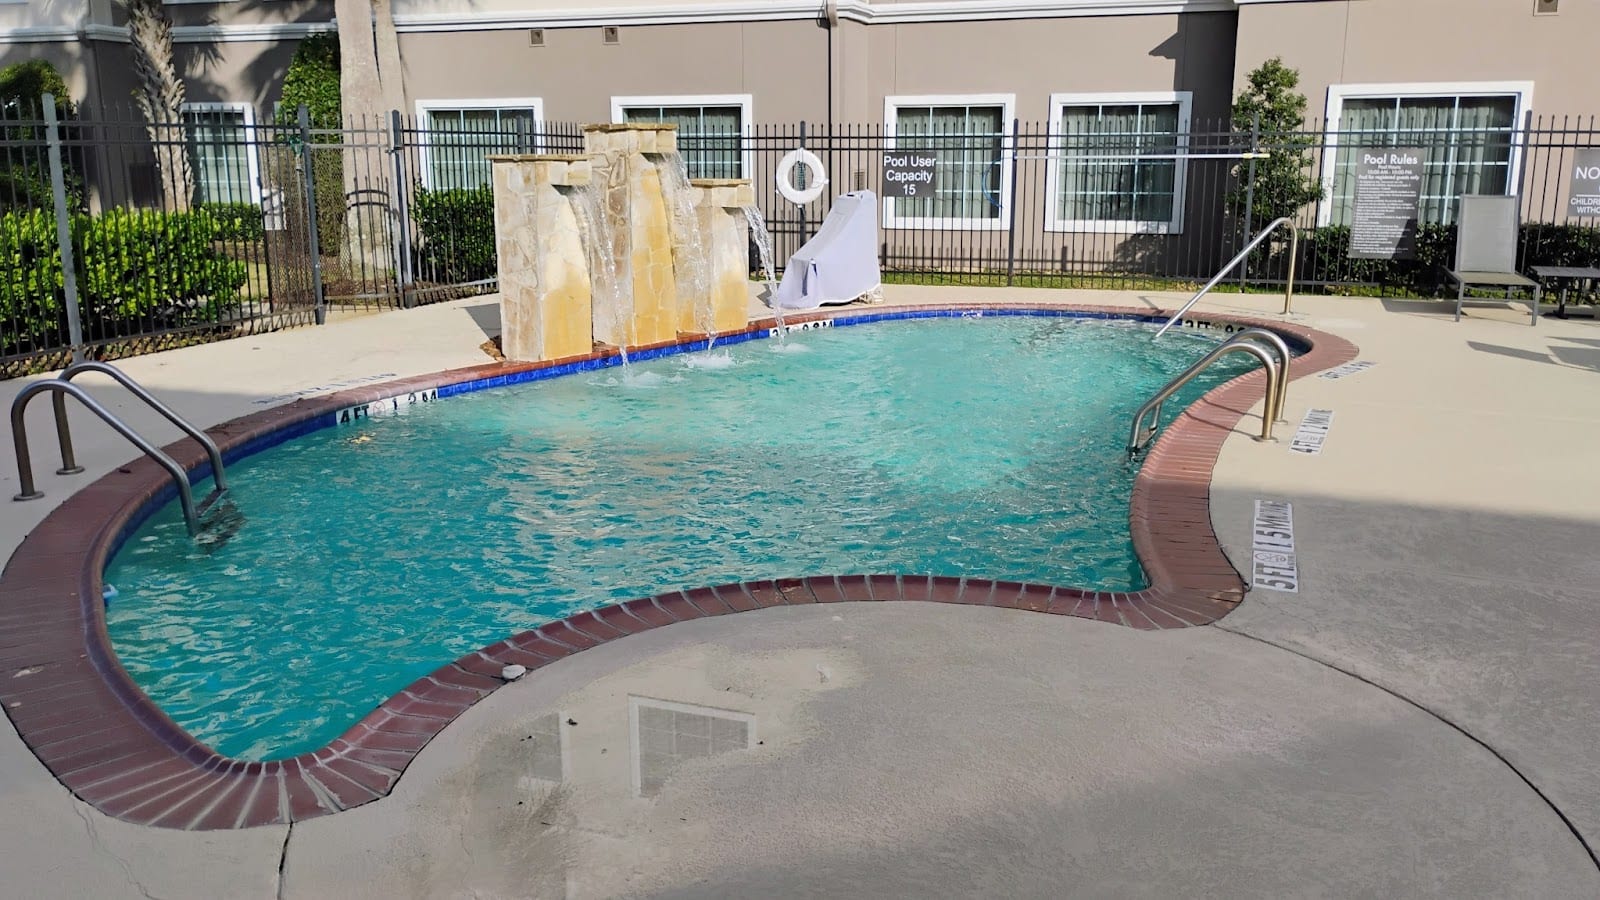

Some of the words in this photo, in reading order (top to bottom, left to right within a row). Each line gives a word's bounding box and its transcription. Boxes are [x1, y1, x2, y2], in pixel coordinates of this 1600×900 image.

[884, 155, 908, 167] Pool
[910, 155, 936, 167] User
[1363, 153, 1387, 164] Pool
[1390, 153, 1418, 165] Rules
[886, 169, 933, 184] Capacity
[902, 184, 916, 195] 15
